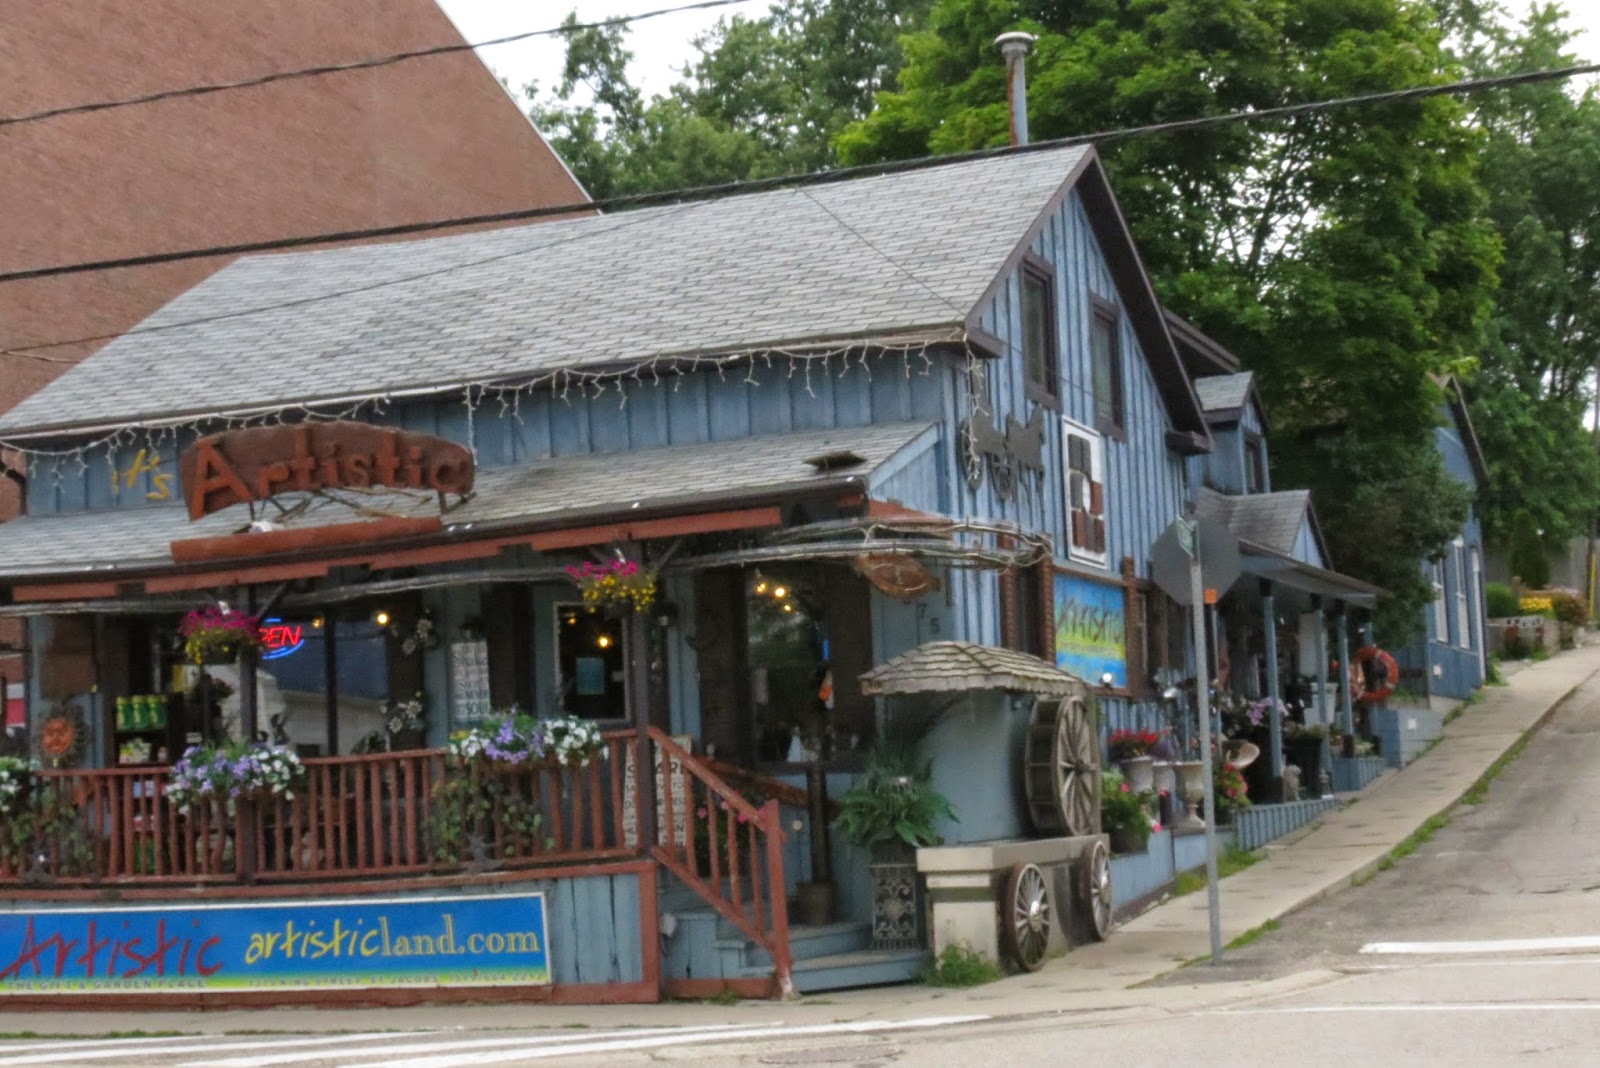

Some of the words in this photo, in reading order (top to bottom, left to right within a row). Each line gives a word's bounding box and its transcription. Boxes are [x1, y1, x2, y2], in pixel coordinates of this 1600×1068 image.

[191, 427, 468, 521] Artistic
[258, 624, 302, 648] PEN
[0, 914, 222, 980] Artistic
[245, 914, 539, 964] artisticland.com
[8, 980, 33, 990] THE
[41, 980, 72, 990] GIFT
[94, 979, 151, 989] GARDEN
[158, 978, 206, 988] PLACE
[390, 975, 440, 983] JACOBS
